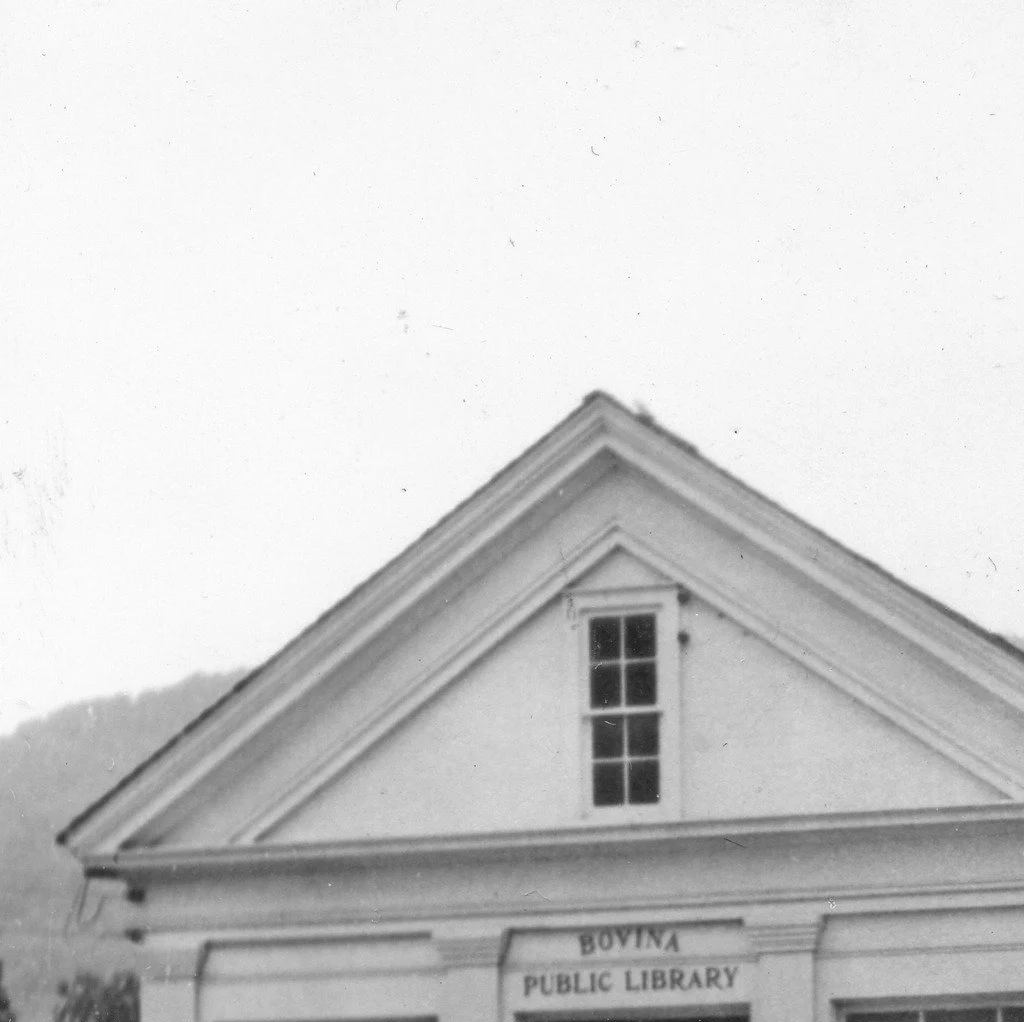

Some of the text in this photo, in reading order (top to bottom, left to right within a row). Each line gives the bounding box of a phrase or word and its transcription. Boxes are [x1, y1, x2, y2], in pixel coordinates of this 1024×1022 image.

[579, 926, 680, 956] BOVINA
[523, 966, 738, 997] PUBLIC LIBRARY
